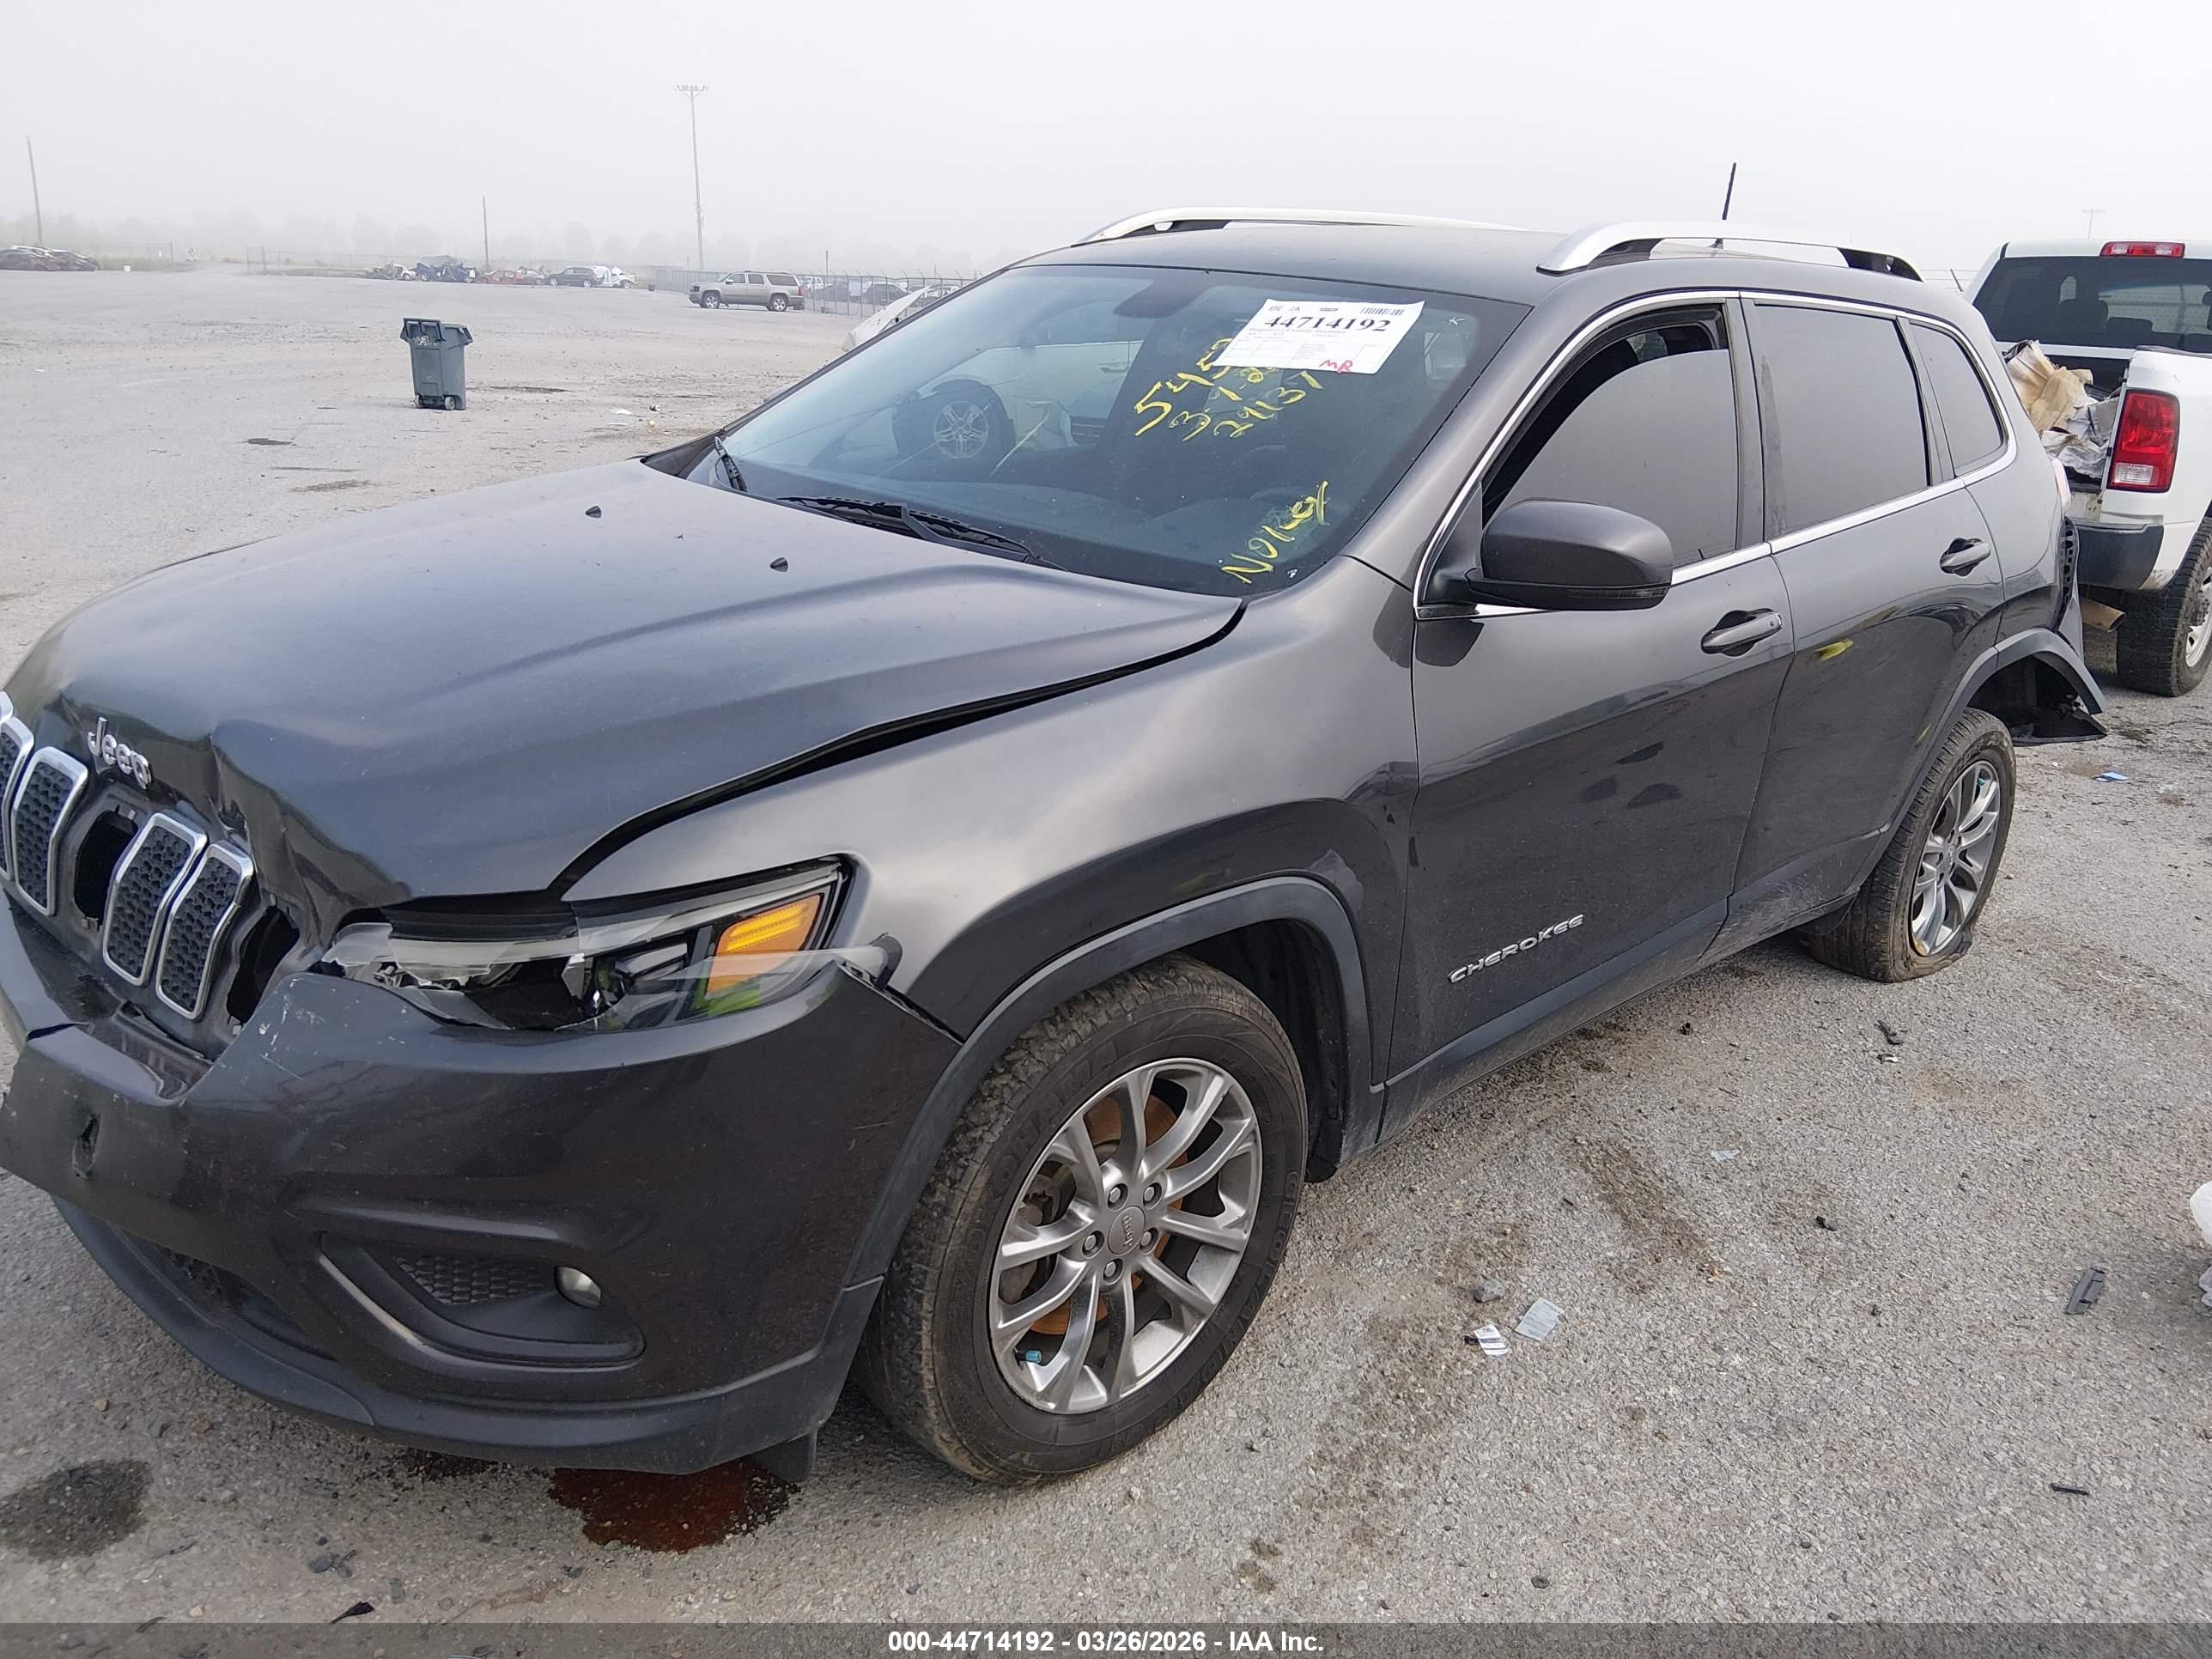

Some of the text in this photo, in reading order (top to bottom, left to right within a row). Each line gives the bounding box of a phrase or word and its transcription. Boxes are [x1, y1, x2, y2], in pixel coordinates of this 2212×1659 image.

[1264, 315, 1392, 332] 44714192
[88, 717, 152, 789] Jeep
[1449, 914, 1584, 983] CHEROKEE
